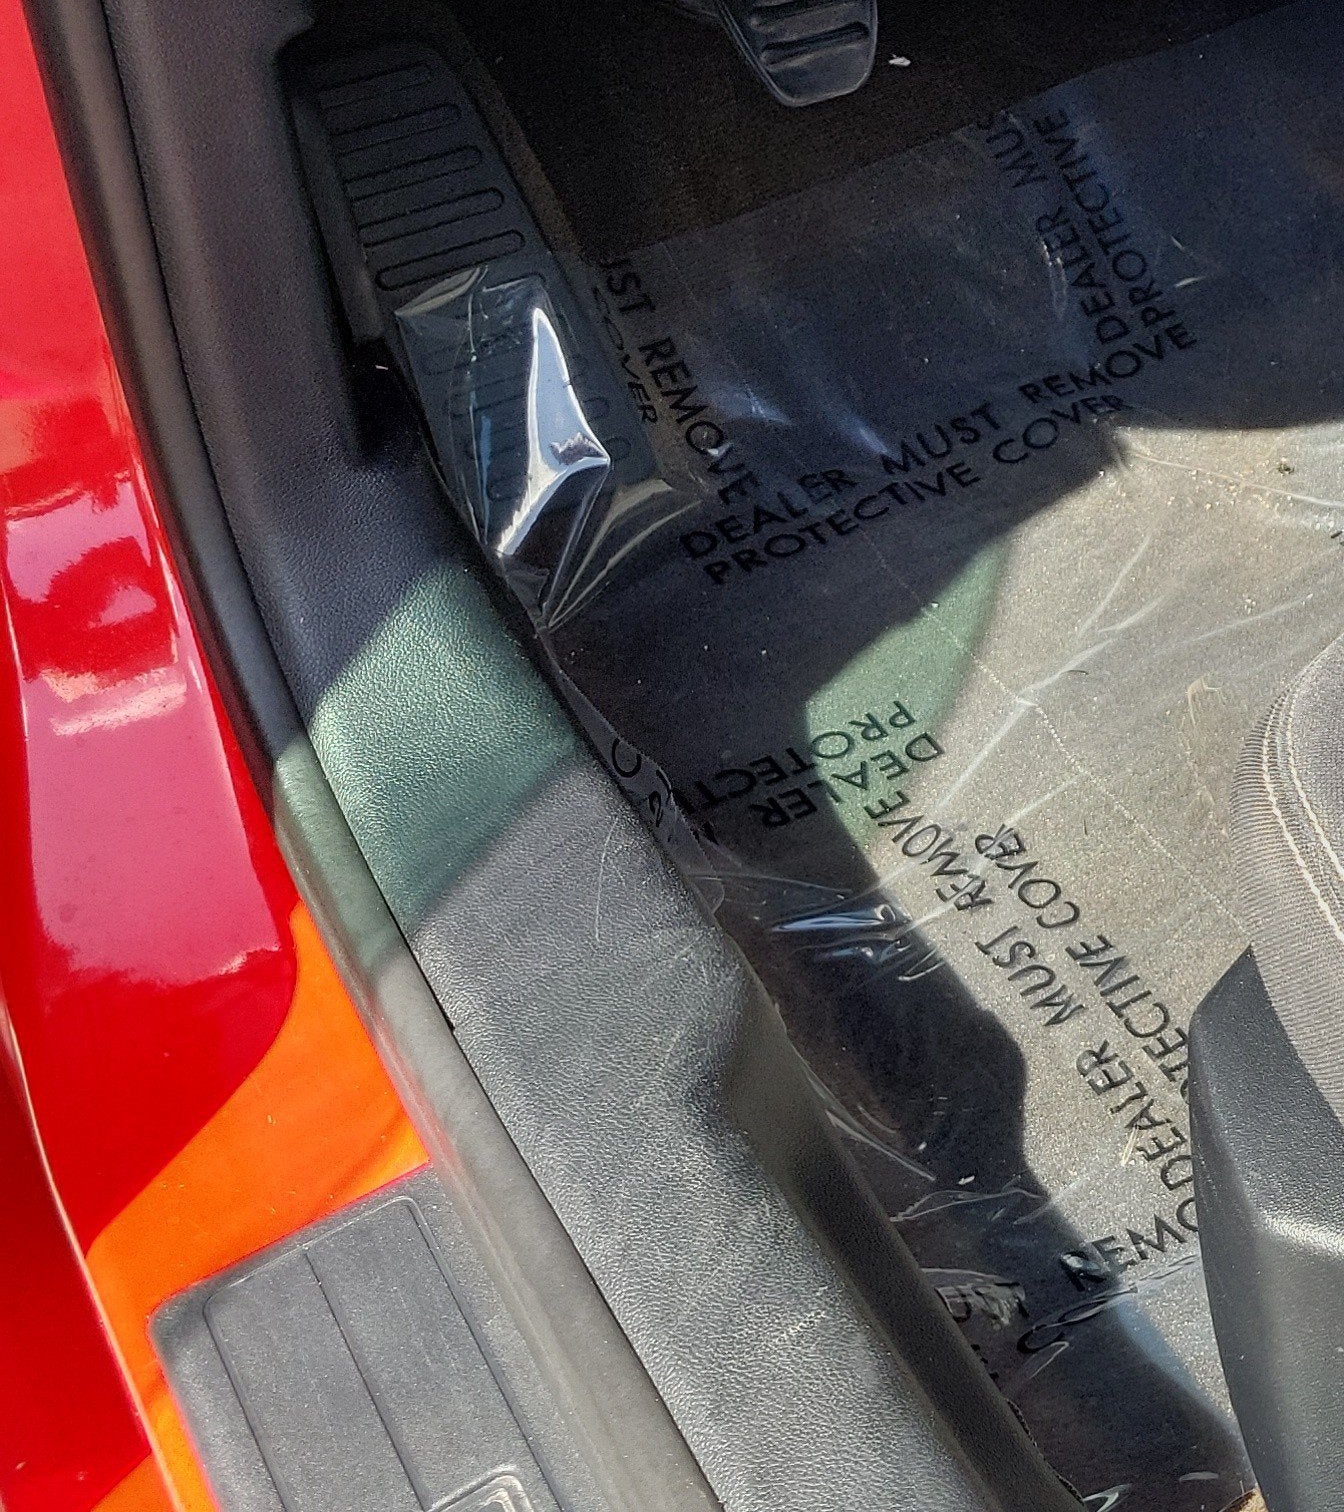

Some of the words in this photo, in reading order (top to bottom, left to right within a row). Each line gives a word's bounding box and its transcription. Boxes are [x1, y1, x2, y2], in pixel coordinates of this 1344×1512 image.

[1033, 109, 1176, 328] PROTECTIVE
[638, 337, 760, 507] REMOVE
[678, 466, 856, 562] DEALER
[881, 402, 1001, 476] MUST
[1019, 319, 1198, 405] REMOVE
[703, 460, 983, 585] PROTECTIVE
[991, 392, 1131, 466] COVER
[749, 731, 945, 828] DEALER
[863, 789, 995, 912] REMOVE
[975, 824, 1081, 931] COVER
[975, 925, 1087, 1028] MUST
[1065, 934, 1190, 1090] TECTIVE
[1075, 1039, 1194, 1190] DEALER
